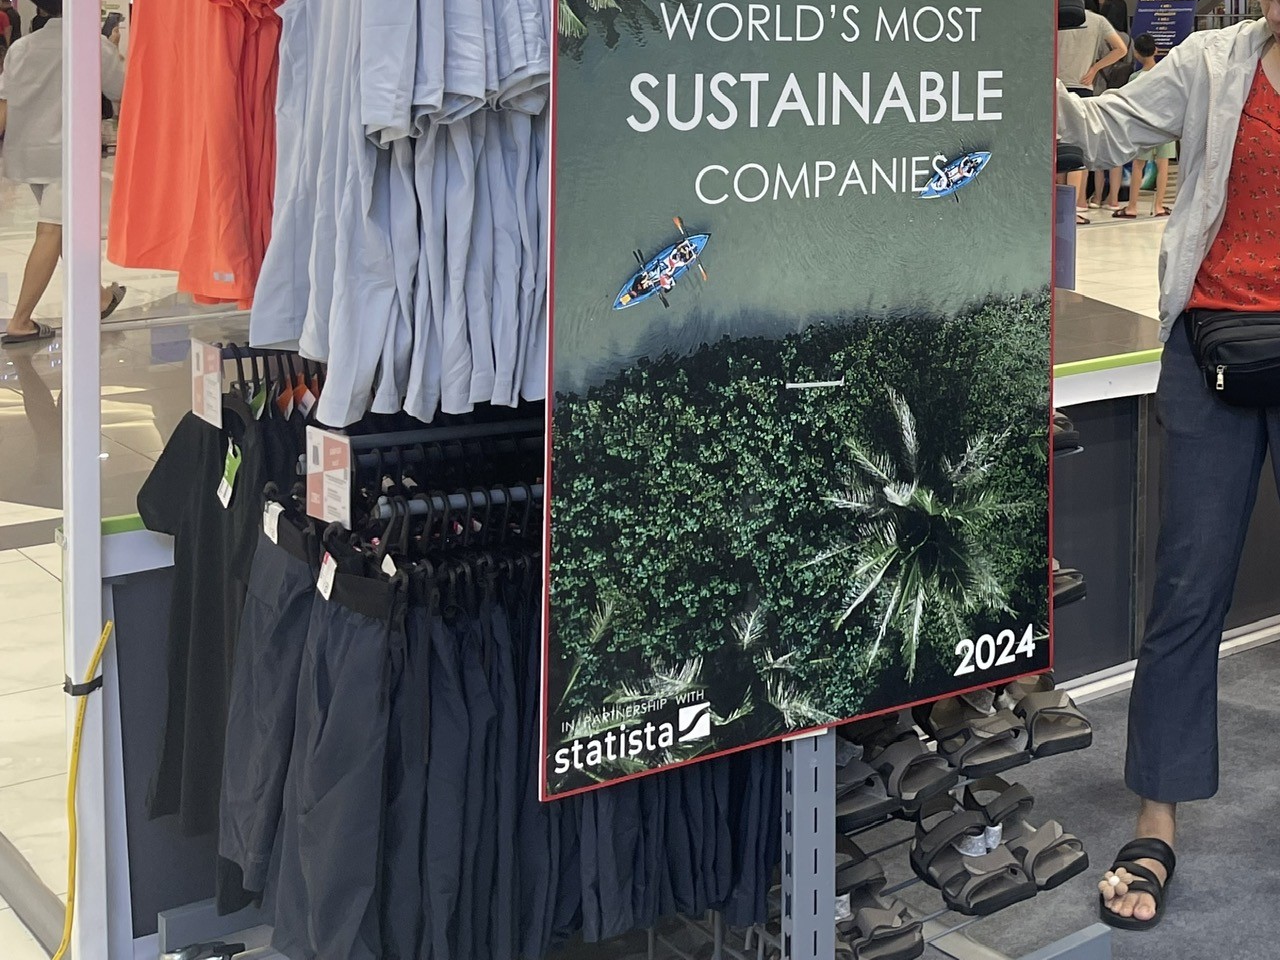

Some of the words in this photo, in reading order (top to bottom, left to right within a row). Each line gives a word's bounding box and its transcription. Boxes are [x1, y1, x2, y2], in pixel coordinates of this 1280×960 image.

[661, 3, 860, 42] WORLD'S
[875, 7, 982, 42] MOST
[626, 70, 1003, 132] SUSTAINABLE
[695, 153, 948, 205] COMPANIES
[953, 624, 1036, 677] 2024
[562, 720, 574, 733] IN
[584, 699, 667, 728] PARTNERSHIP
[676, 690, 704, 705] WITH
[555, 722, 673, 774] statista
